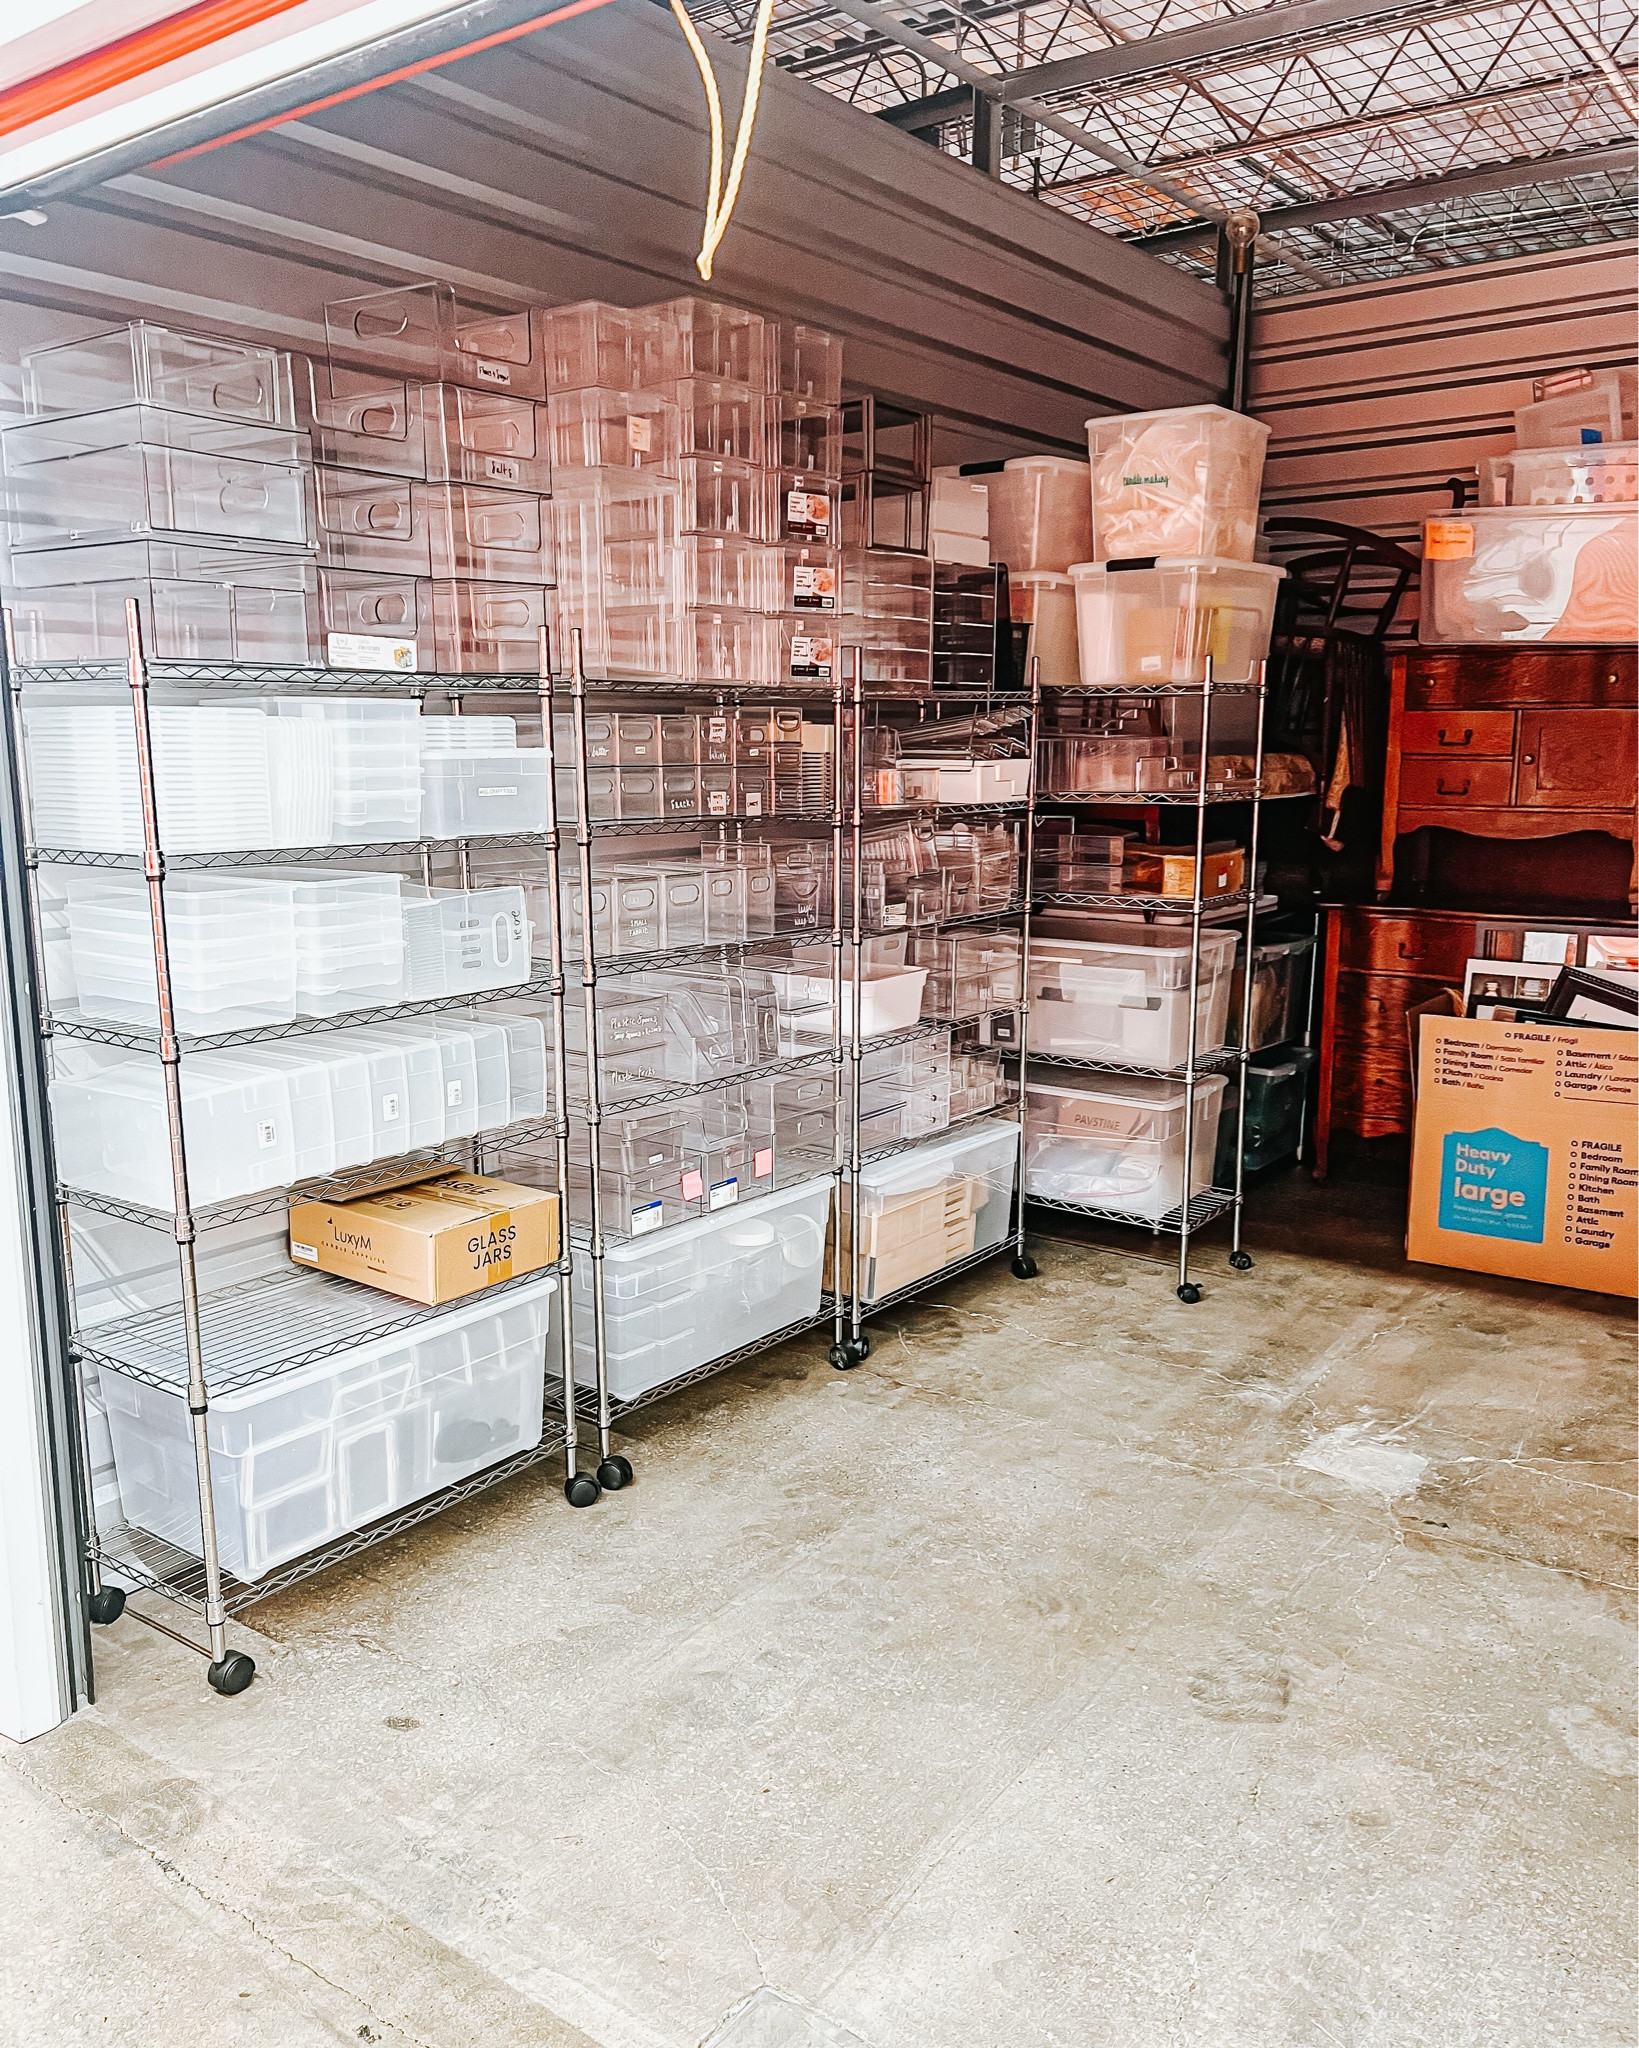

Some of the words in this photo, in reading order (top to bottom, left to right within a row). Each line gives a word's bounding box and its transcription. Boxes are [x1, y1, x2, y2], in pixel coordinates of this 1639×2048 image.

[1123, 473, 1143, 486] candle
[1144, 473, 1171, 488] making
[630, 919, 648, 927] SMALL
[610, 1017, 636, 1030] Plastic
[1514, 1032, 1551, 1042] FRAGILE
[1443, 1038, 1480, 1049] Bedroom
[1443, 1048, 1469, 1058] Family
[1471, 1052, 1493, 1060] Room
[1518, 1057, 1545, 1065] familiar
[1566, 1050, 1611, 1060] Basement
[1443, 1058, 1468, 1068] Dining
[1470, 1062, 1493, 1070] Room
[1499, 1065, 1533, 1074] Comedor
[1565, 1060, 1587, 1069] Attic
[1442, 1068, 1473, 1078] Kitchen
[1479, 1073, 1504, 1082] Cocina
[1564, 1070, 1602, 1081] Laundry
[1442, 1078, 1461, 1086] Bath
[1564, 1081, 1597, 1092] Garage
[1605, 1085, 1631, 1093] Garaje
[1581, 1140, 1622, 1152] FRAGILE
[1456, 1142, 1511, 1165] Heavy
[1581, 1152, 1623, 1163] Bedroom
[1455, 1158, 1496, 1180] Duty
[1580, 1162, 1611, 1174] Family
[1579, 1173, 1609, 1185] Dining
[433, 1178, 500, 1195] RAGILE
[1579, 1184, 1615, 1195] Kitchen
[1454, 1176, 1526, 1210] large
[1578, 1194, 1600, 1204] Bath
[1577, 1205, 1624, 1218] Basement
[1576, 1216, 1599, 1225] Attic
[334, 1225, 372, 1251] LuxyM
[1575, 1226, 1615, 1239] Laundry
[467, 1225, 517, 1253] GLASS
[1575, 1237, 1610, 1249] Garage
[473, 1245, 512, 1270] JARS
